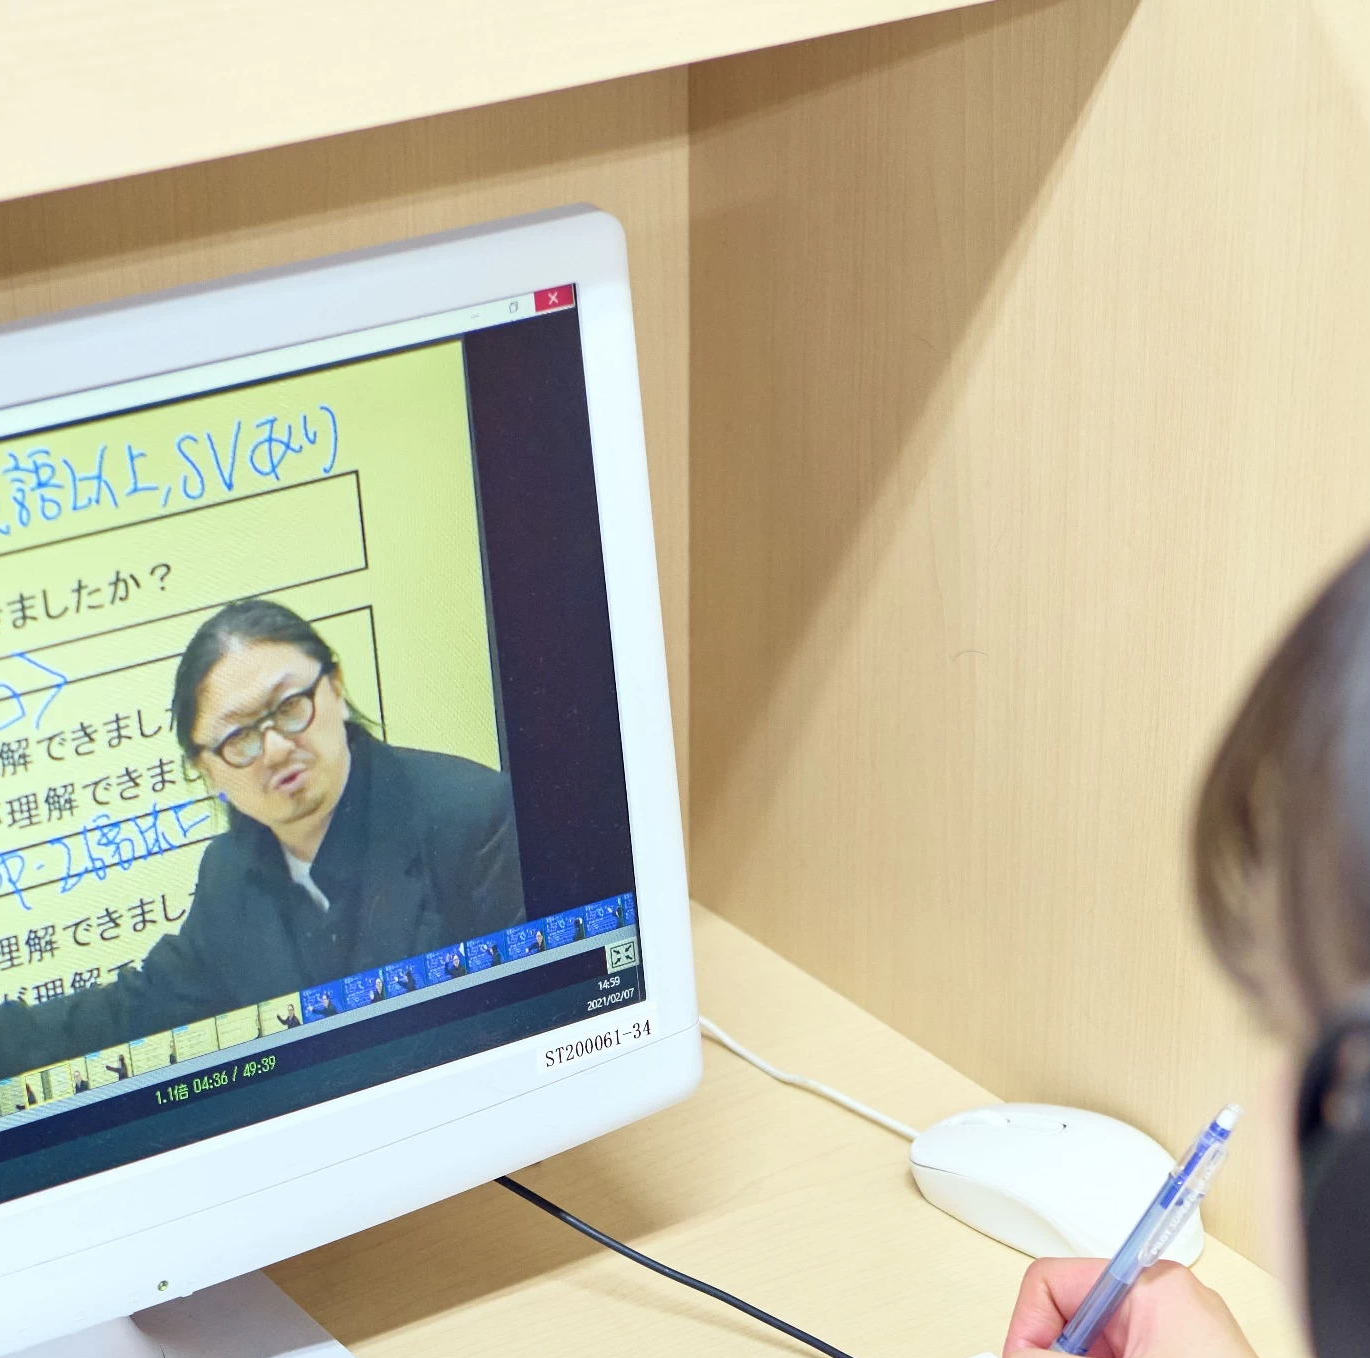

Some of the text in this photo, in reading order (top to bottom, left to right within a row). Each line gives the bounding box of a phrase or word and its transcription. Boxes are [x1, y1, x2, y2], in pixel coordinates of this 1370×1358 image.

[587, 988, 634, 1011] 2021/02/07
[598, 976, 621, 991] 14:59
[545, 1019, 652, 1068] ST200061-34
[155, 1083, 189, 1105] 1.1倍
[192, 1070, 229, 1094] 04:36
[242, 1055, 276, 1078] 49:39
